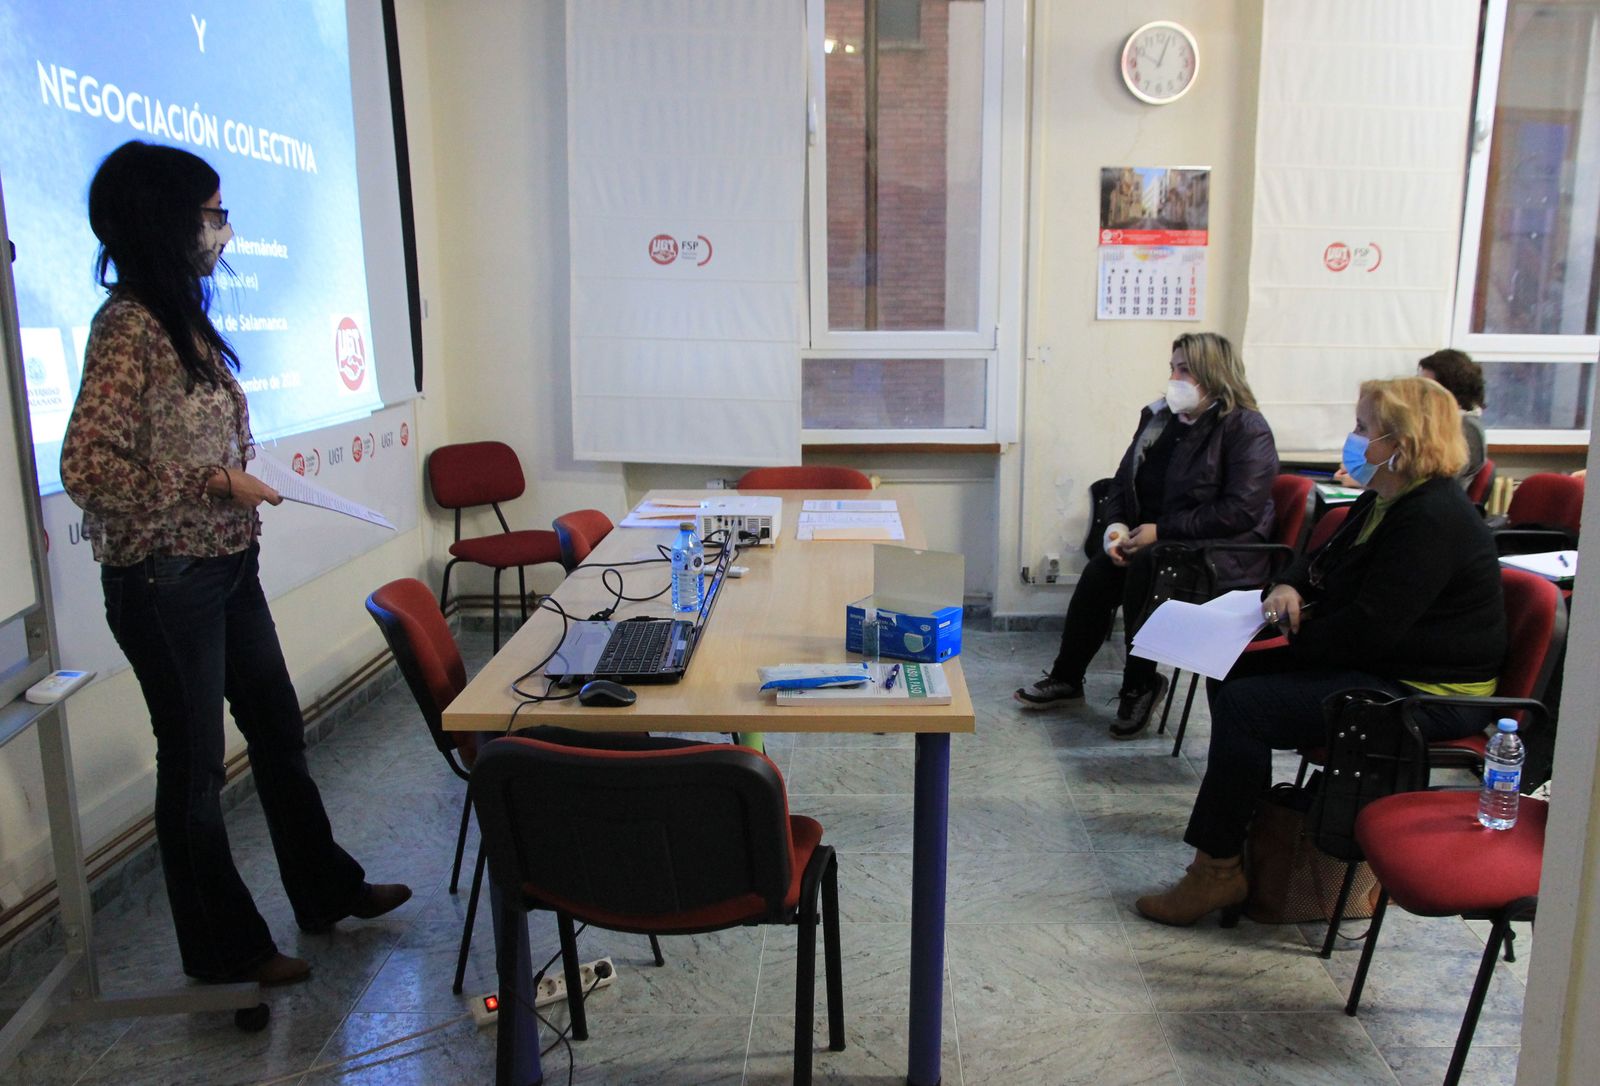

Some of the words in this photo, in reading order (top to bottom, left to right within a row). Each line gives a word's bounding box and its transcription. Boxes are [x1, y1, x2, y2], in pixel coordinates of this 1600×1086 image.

[191, 14, 207, 53] Y
[36, 60, 219, 150] NEGOCIACIÓN
[223, 119, 318, 174] COLECTIVA
[236, 236, 288, 259] Hernández
[681, 241, 698, 250] FSP
[225, 314, 238, 331] de
[240, 313, 288, 331] Salamanca
[381, 432, 394, 448] UGT
[328, 447, 344, 465] UGT
[910, 681, 922, 694] PASO
